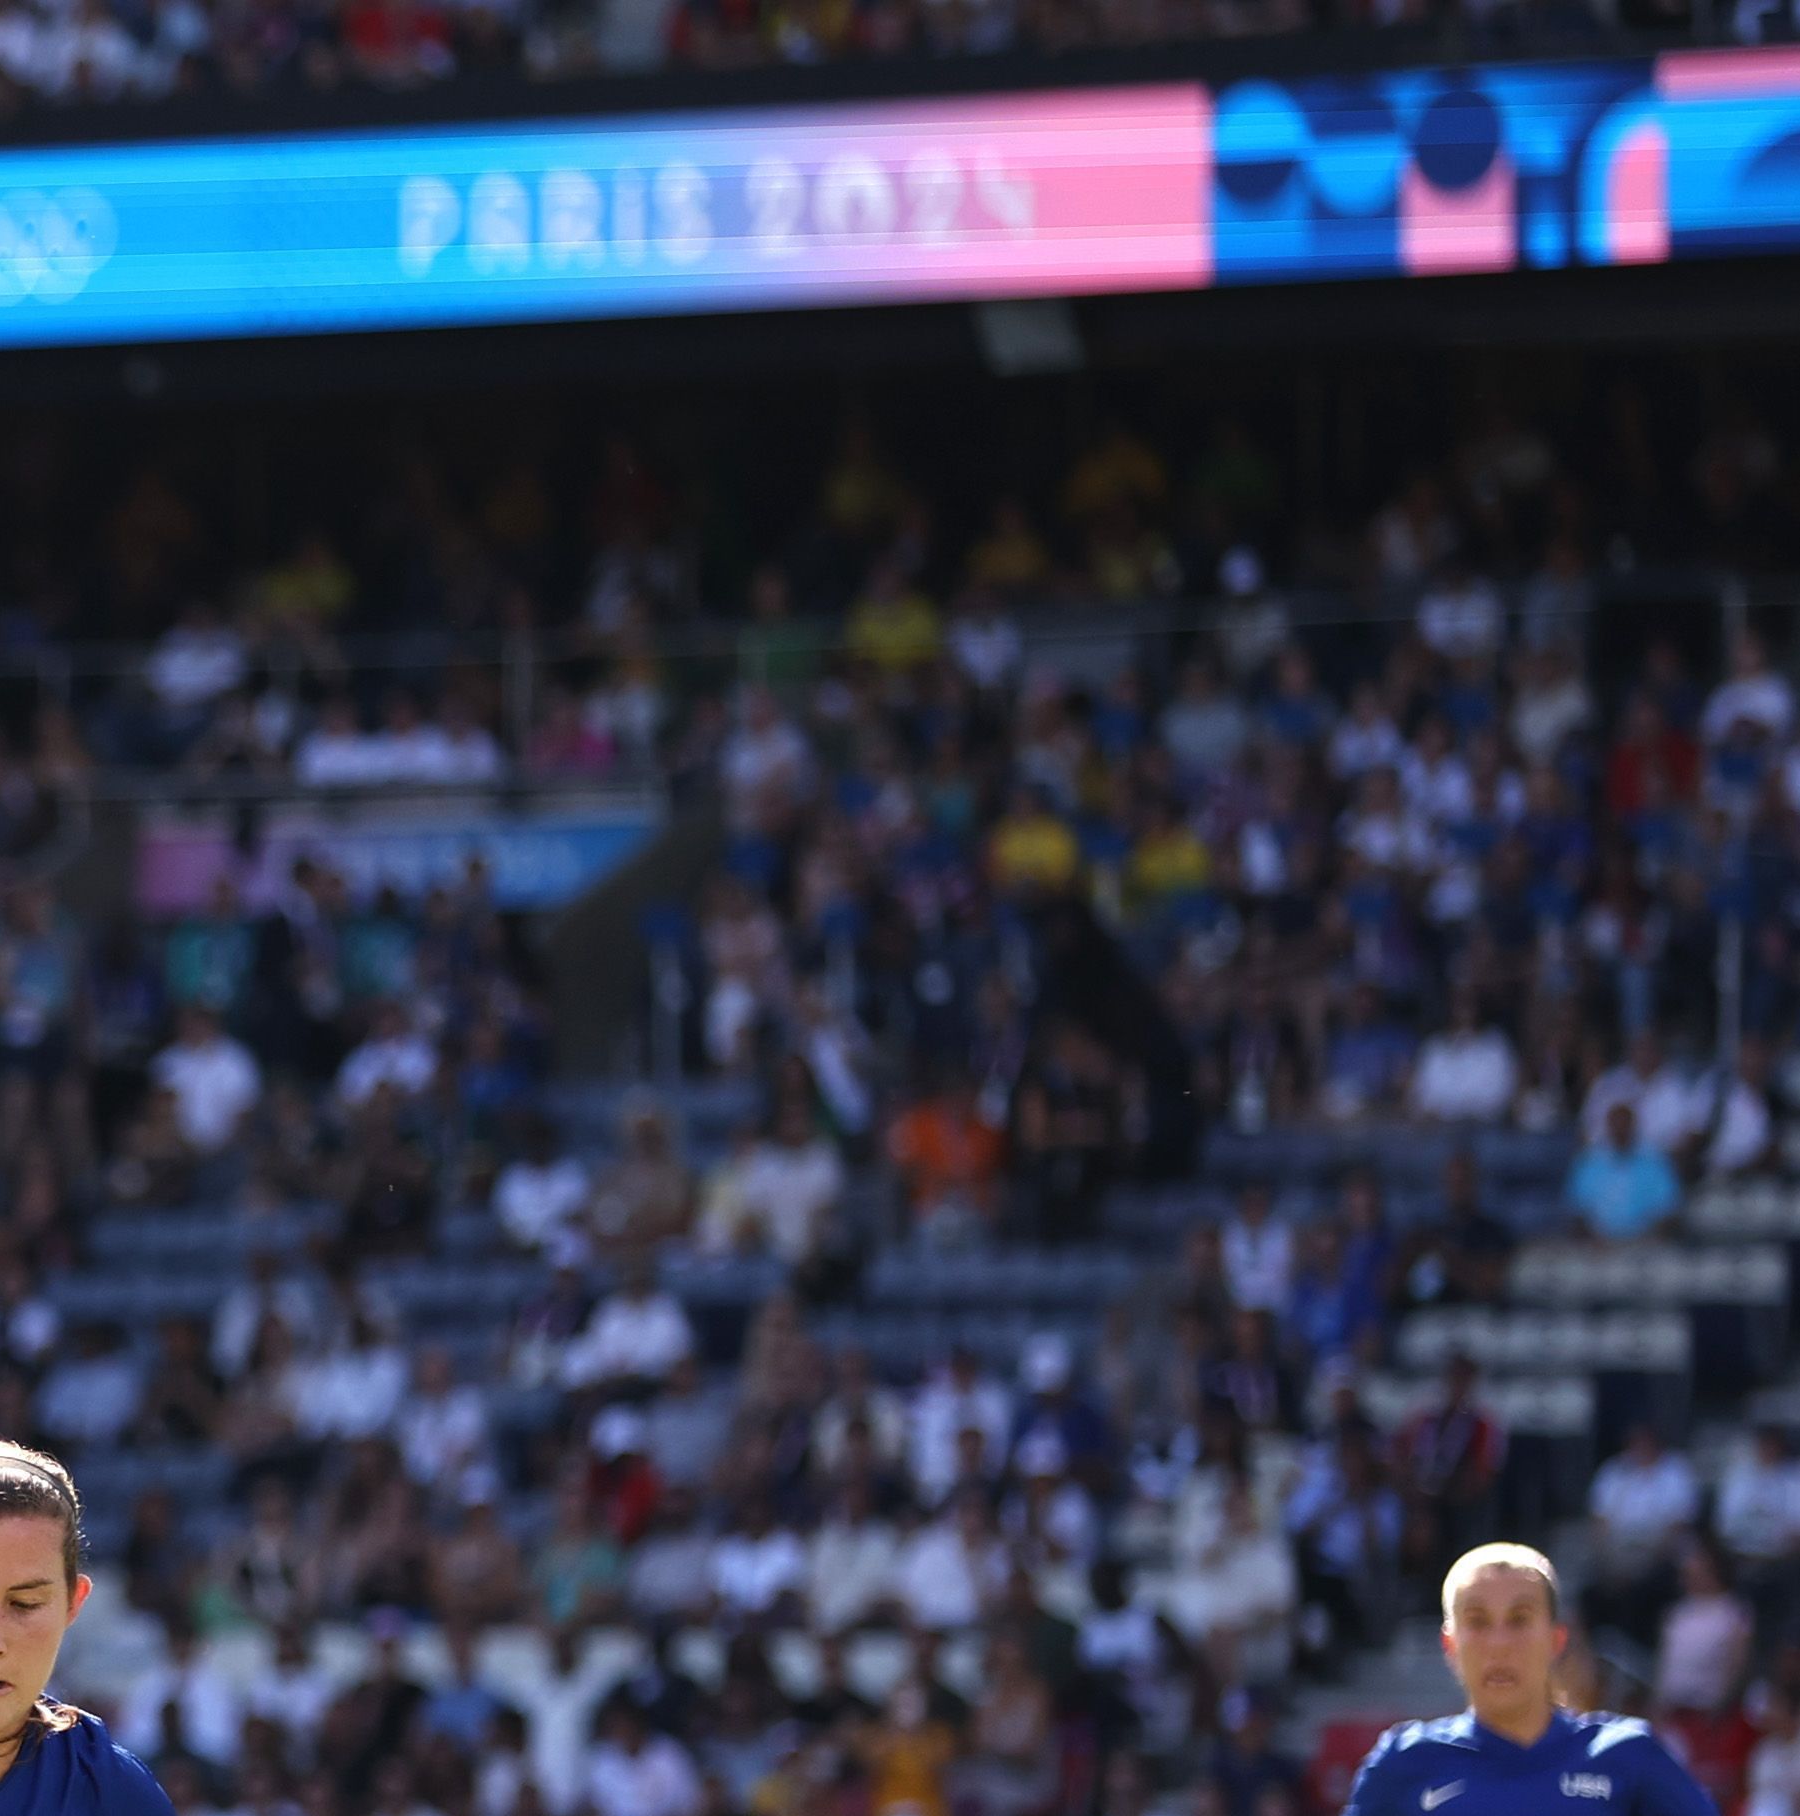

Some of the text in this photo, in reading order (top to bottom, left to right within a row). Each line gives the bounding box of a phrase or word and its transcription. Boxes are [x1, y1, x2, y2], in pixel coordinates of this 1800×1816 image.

[397, 141, 1036, 278] PARIS 2024
[1559, 1771, 1612, 1801] USA
